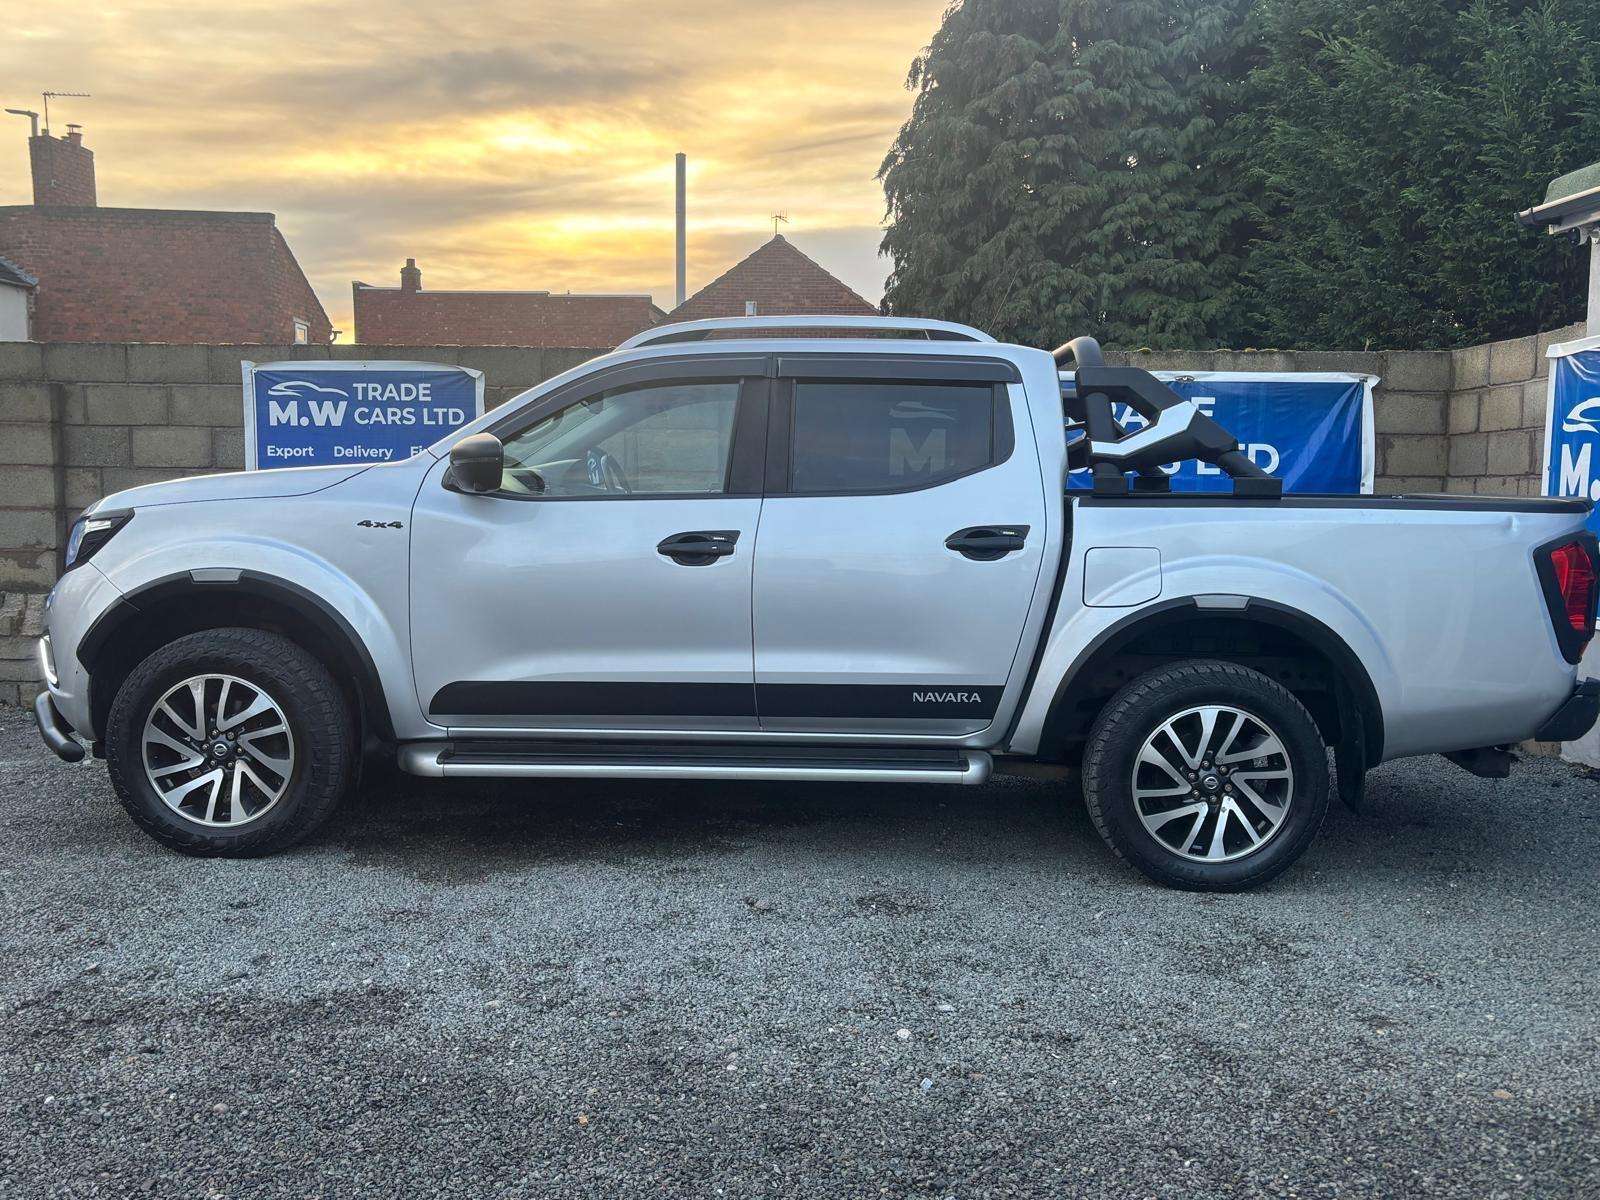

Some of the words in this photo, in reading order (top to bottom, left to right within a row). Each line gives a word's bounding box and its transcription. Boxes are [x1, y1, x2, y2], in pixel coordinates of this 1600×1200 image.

[353, 383, 432, 401] TRADE
[268, 400, 348, 427] M.W
[354, 407, 416, 425] CARS
[423, 408, 465, 425] LTD
[267, 445, 315, 458] Export
[333, 445, 394, 460] Delivery
[912, 692, 982, 703] NAVARA
